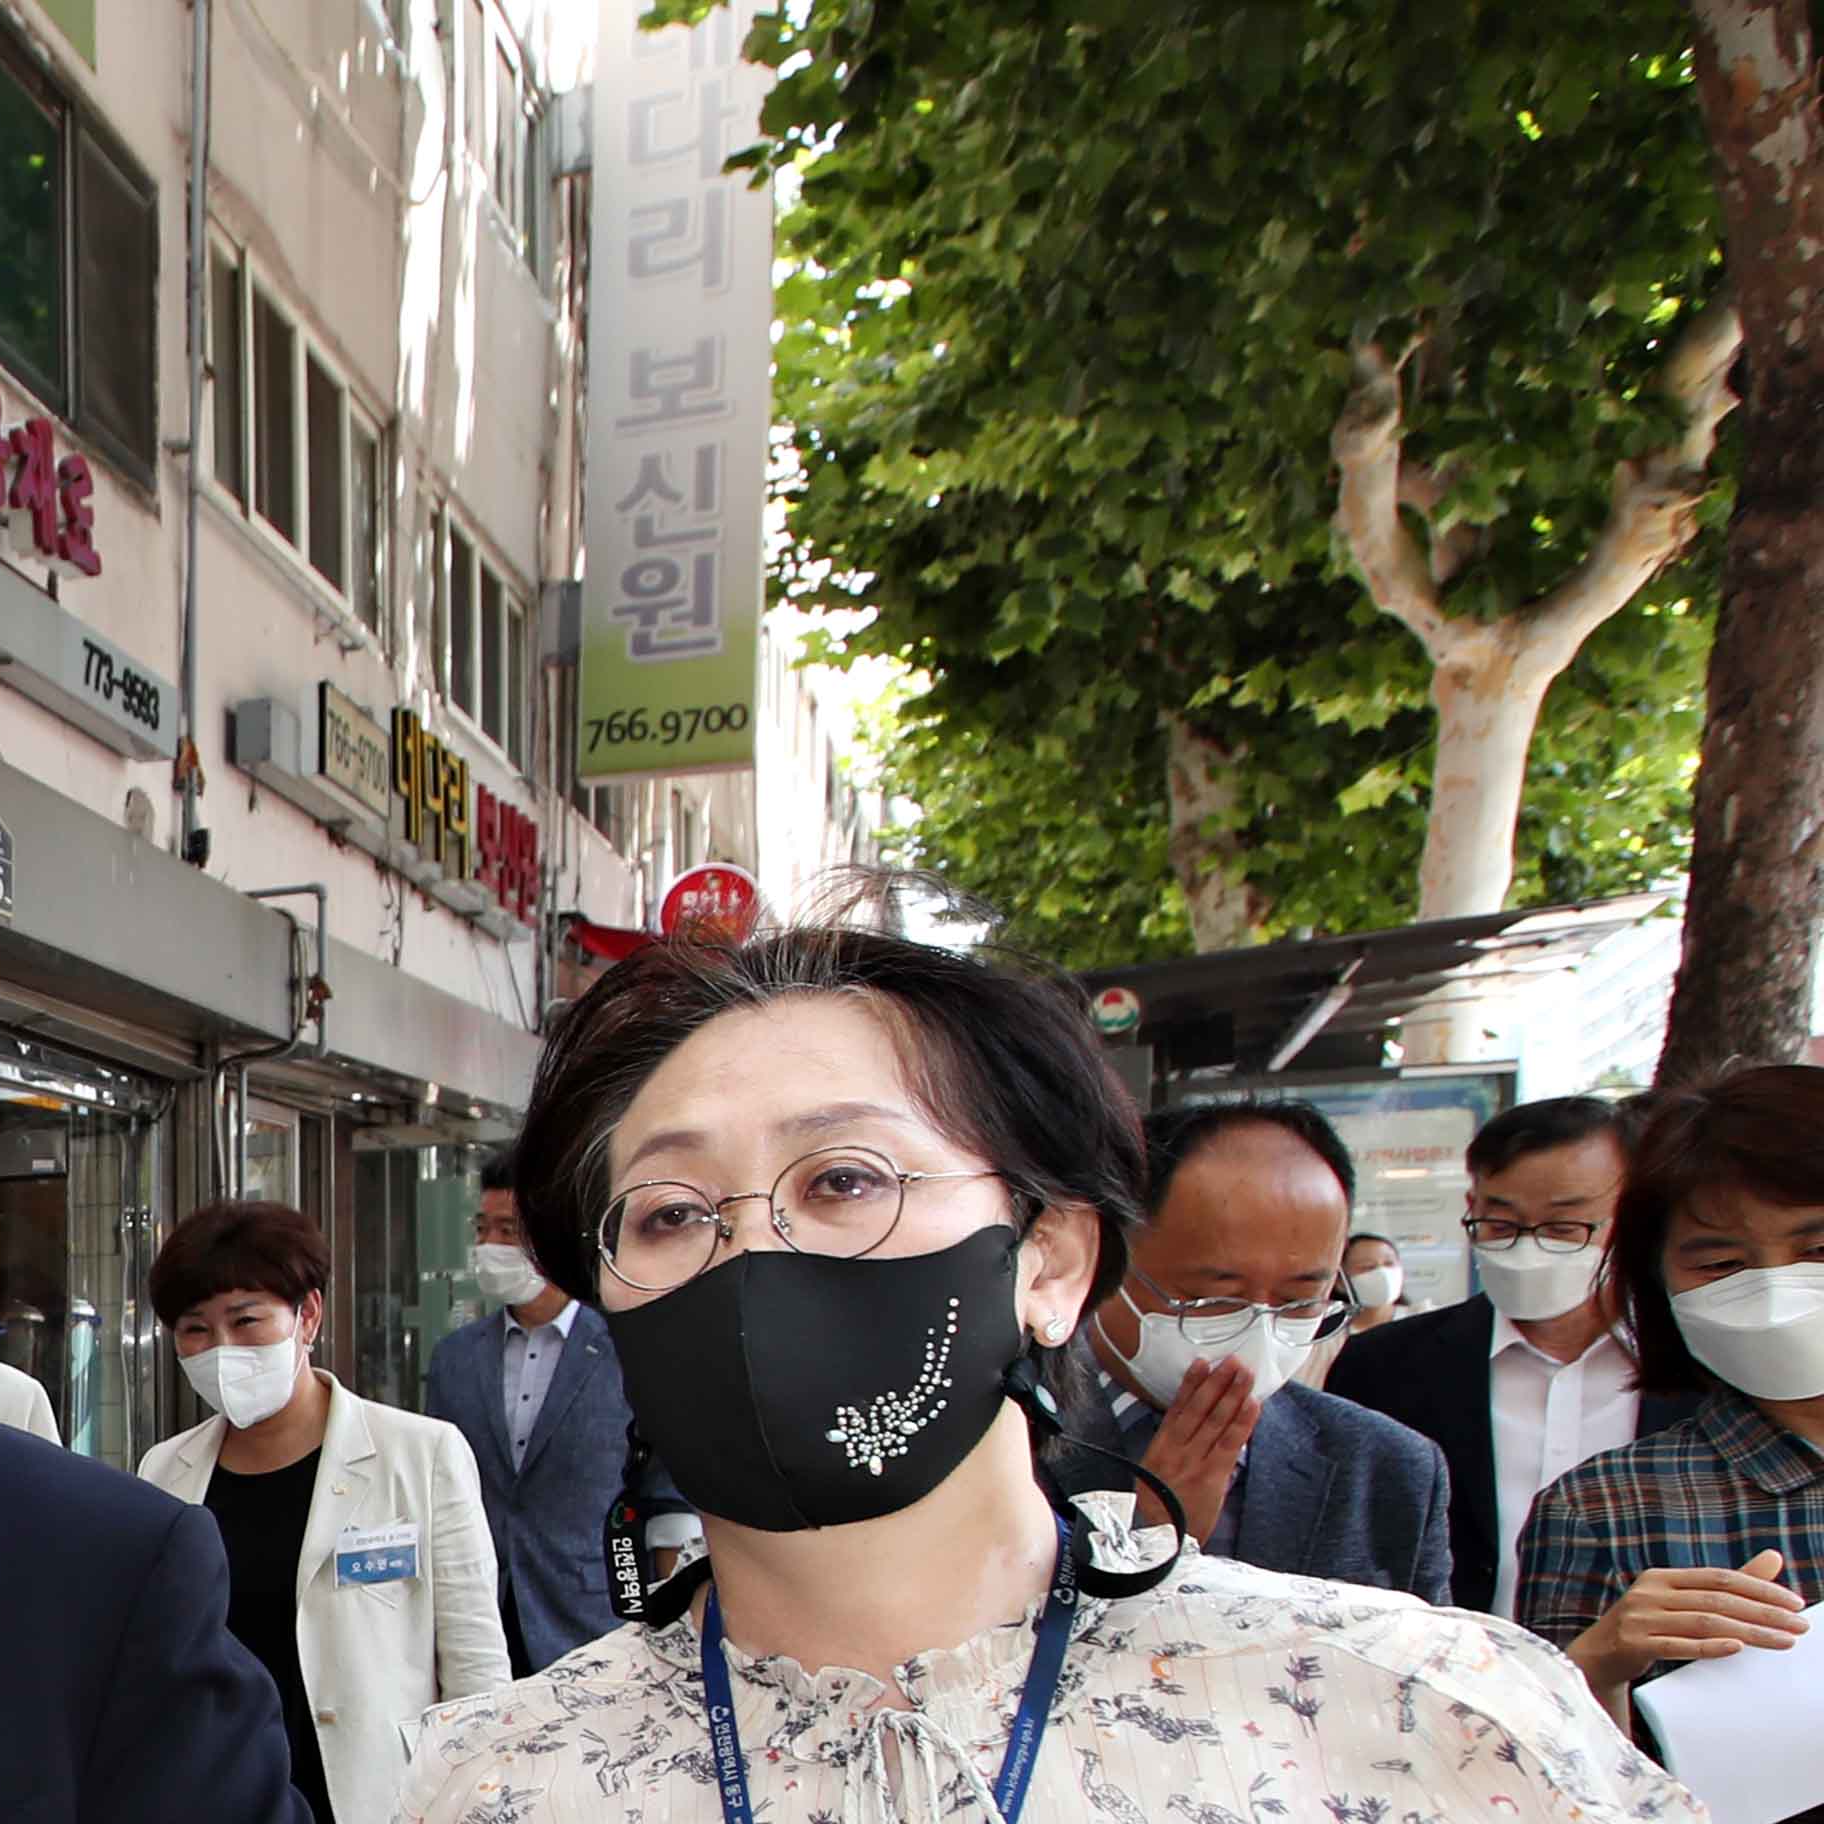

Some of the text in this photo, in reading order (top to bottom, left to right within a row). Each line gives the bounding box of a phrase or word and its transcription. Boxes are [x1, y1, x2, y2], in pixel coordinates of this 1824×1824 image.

[613, 337, 728, 660] 보신원
[586, 702, 750, 753] 766.9700
[612, 1537, 644, 1614] 인천광역시
[715, 1723, 739, 1781] 인천광역시
